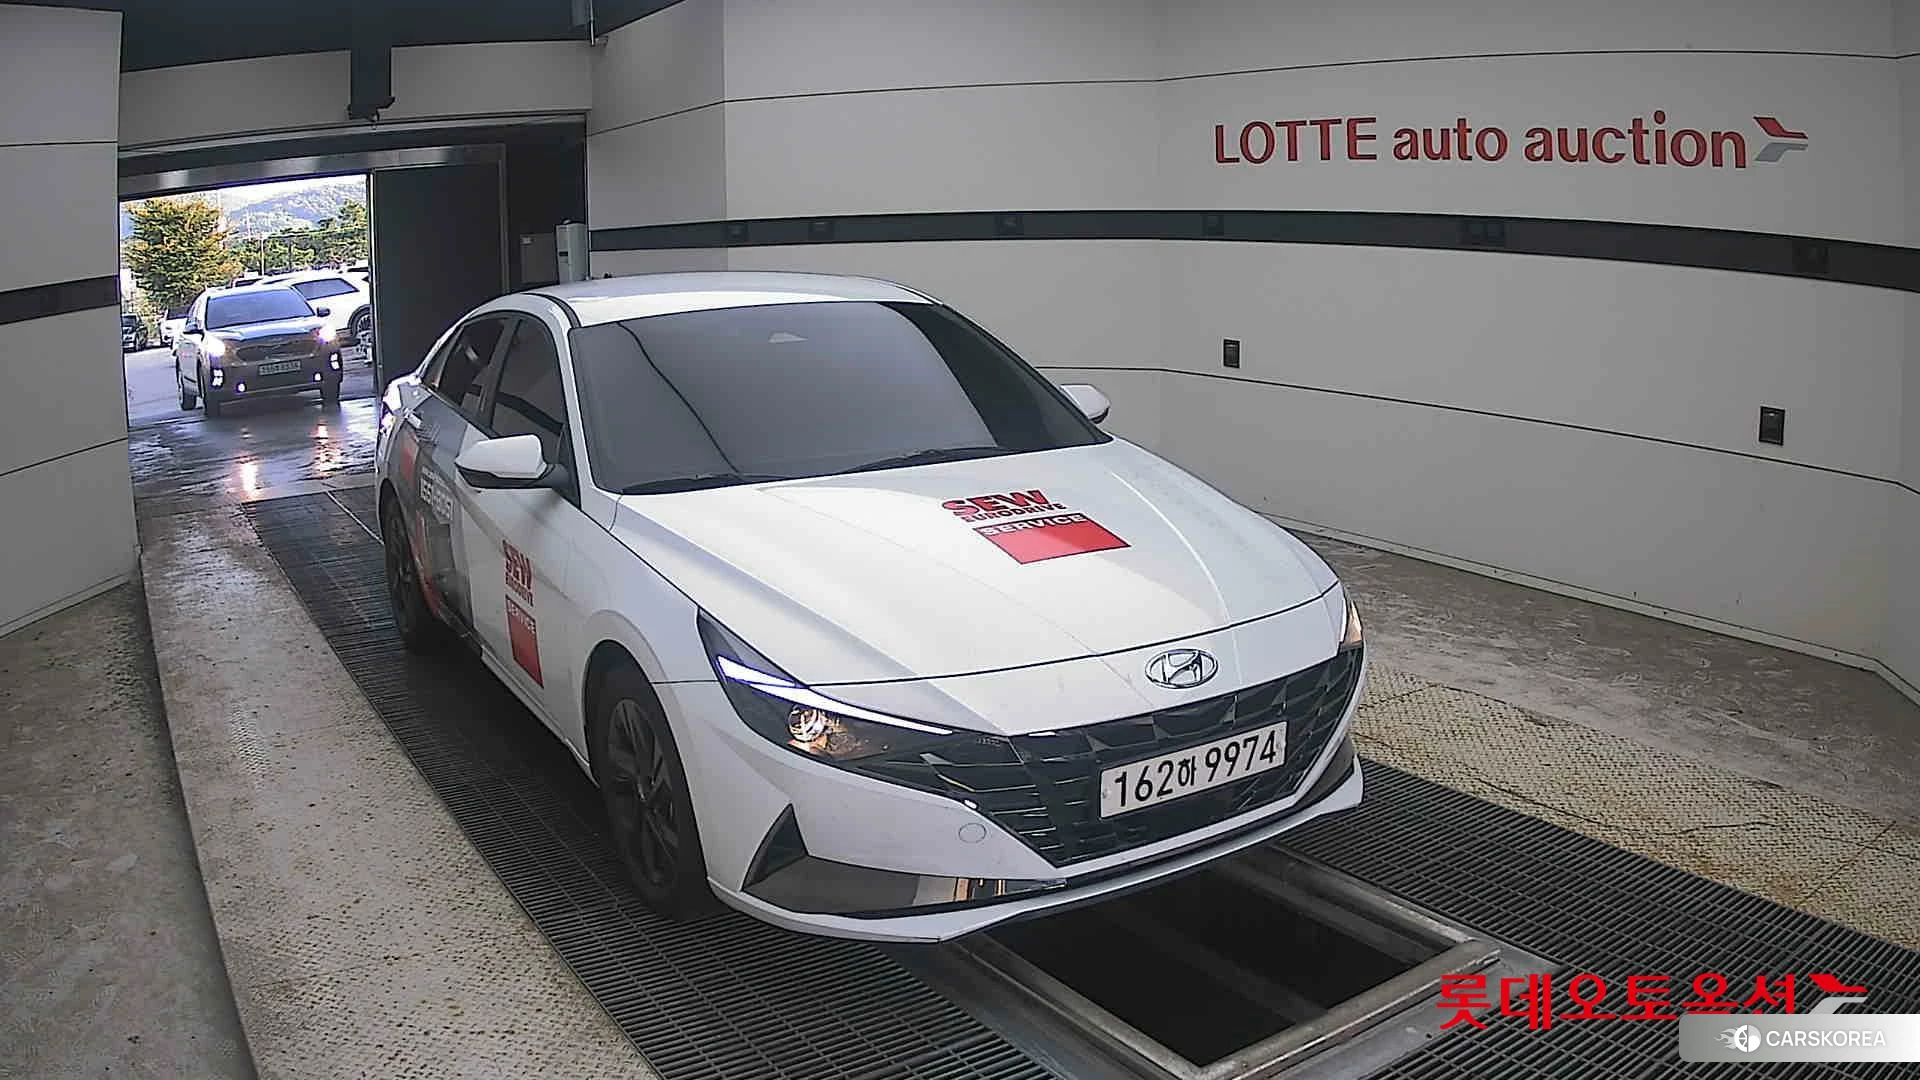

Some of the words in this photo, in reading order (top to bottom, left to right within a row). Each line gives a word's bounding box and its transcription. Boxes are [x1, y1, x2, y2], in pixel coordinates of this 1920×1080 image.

[1215, 117, 1377, 164] LOTTE
[1393, 118, 1508, 161] auto
[1524, 110, 1746, 168] auction
[941, 489, 1050, 517] SEW
[961, 502, 1067, 523] EURODRIVE
[980, 513, 1088, 537] SERVICE
